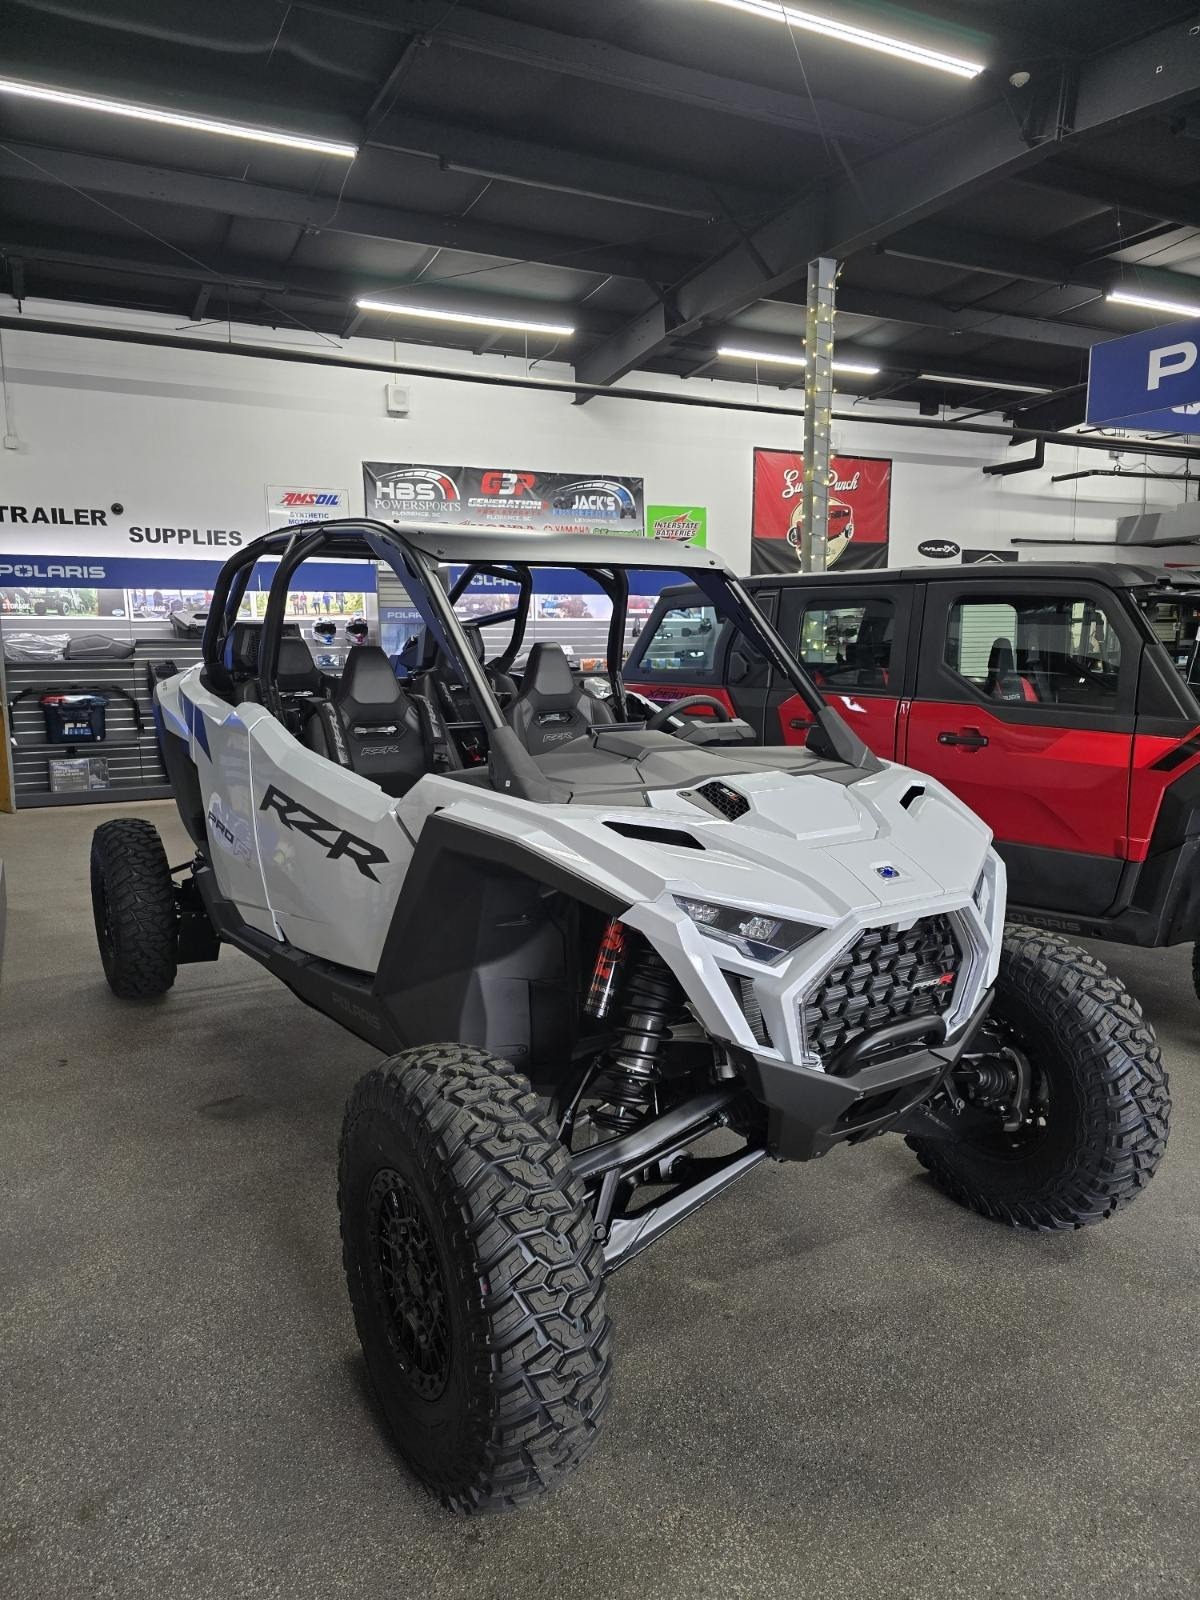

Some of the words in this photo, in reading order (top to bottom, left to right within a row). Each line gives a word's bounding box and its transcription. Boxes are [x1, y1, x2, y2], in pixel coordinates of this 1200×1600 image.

[280, 492, 339, 506] AMSOIL
[375, 481, 435, 500] HBS
[374, 499, 462, 512] POWERSPORTS
[571, 495, 616, 511] JACK'S
[129, 526, 243, 546] SUPPLIES
[656, 529, 696, 537] BATTERIES
[0, 564, 106, 579] POLARIS
[208, 810, 234, 845] PRO
[259, 784, 390, 885] RZR
[1006, 912, 1080, 932] OLARIS
